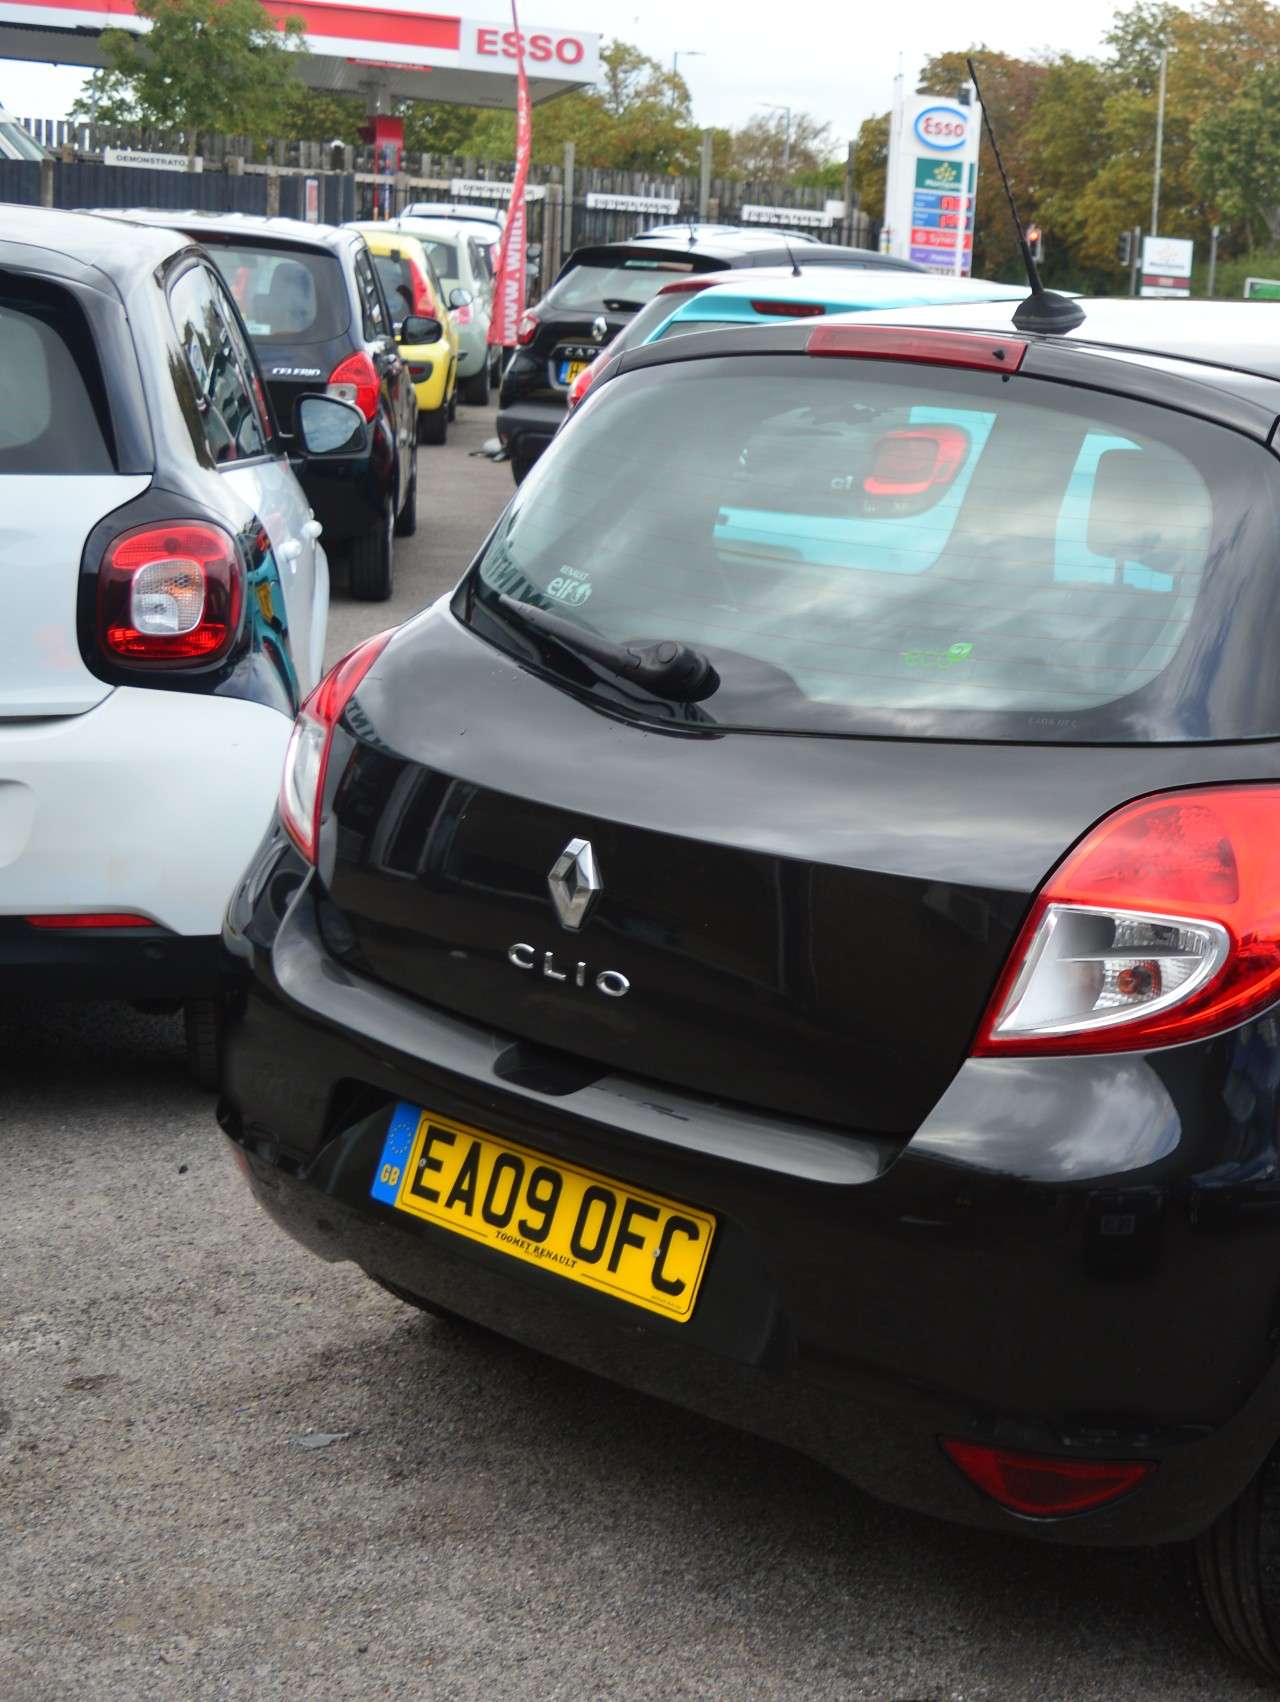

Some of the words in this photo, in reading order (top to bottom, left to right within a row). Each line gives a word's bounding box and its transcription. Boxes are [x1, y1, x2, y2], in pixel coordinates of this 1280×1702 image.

[477, 28, 584, 64] ESSO
[923, 116, 965, 137] Esso
[116, 154, 187, 166] DEMONSTRATO
[547, 577, 580, 600] elf
[508, 943, 631, 997] CLIO
[381, 1163, 400, 1185] GB
[410, 1125, 564, 1244] EA09
[570, 1185, 700, 1297] OFC
[532, 1246, 578, 1269] RENAULT
